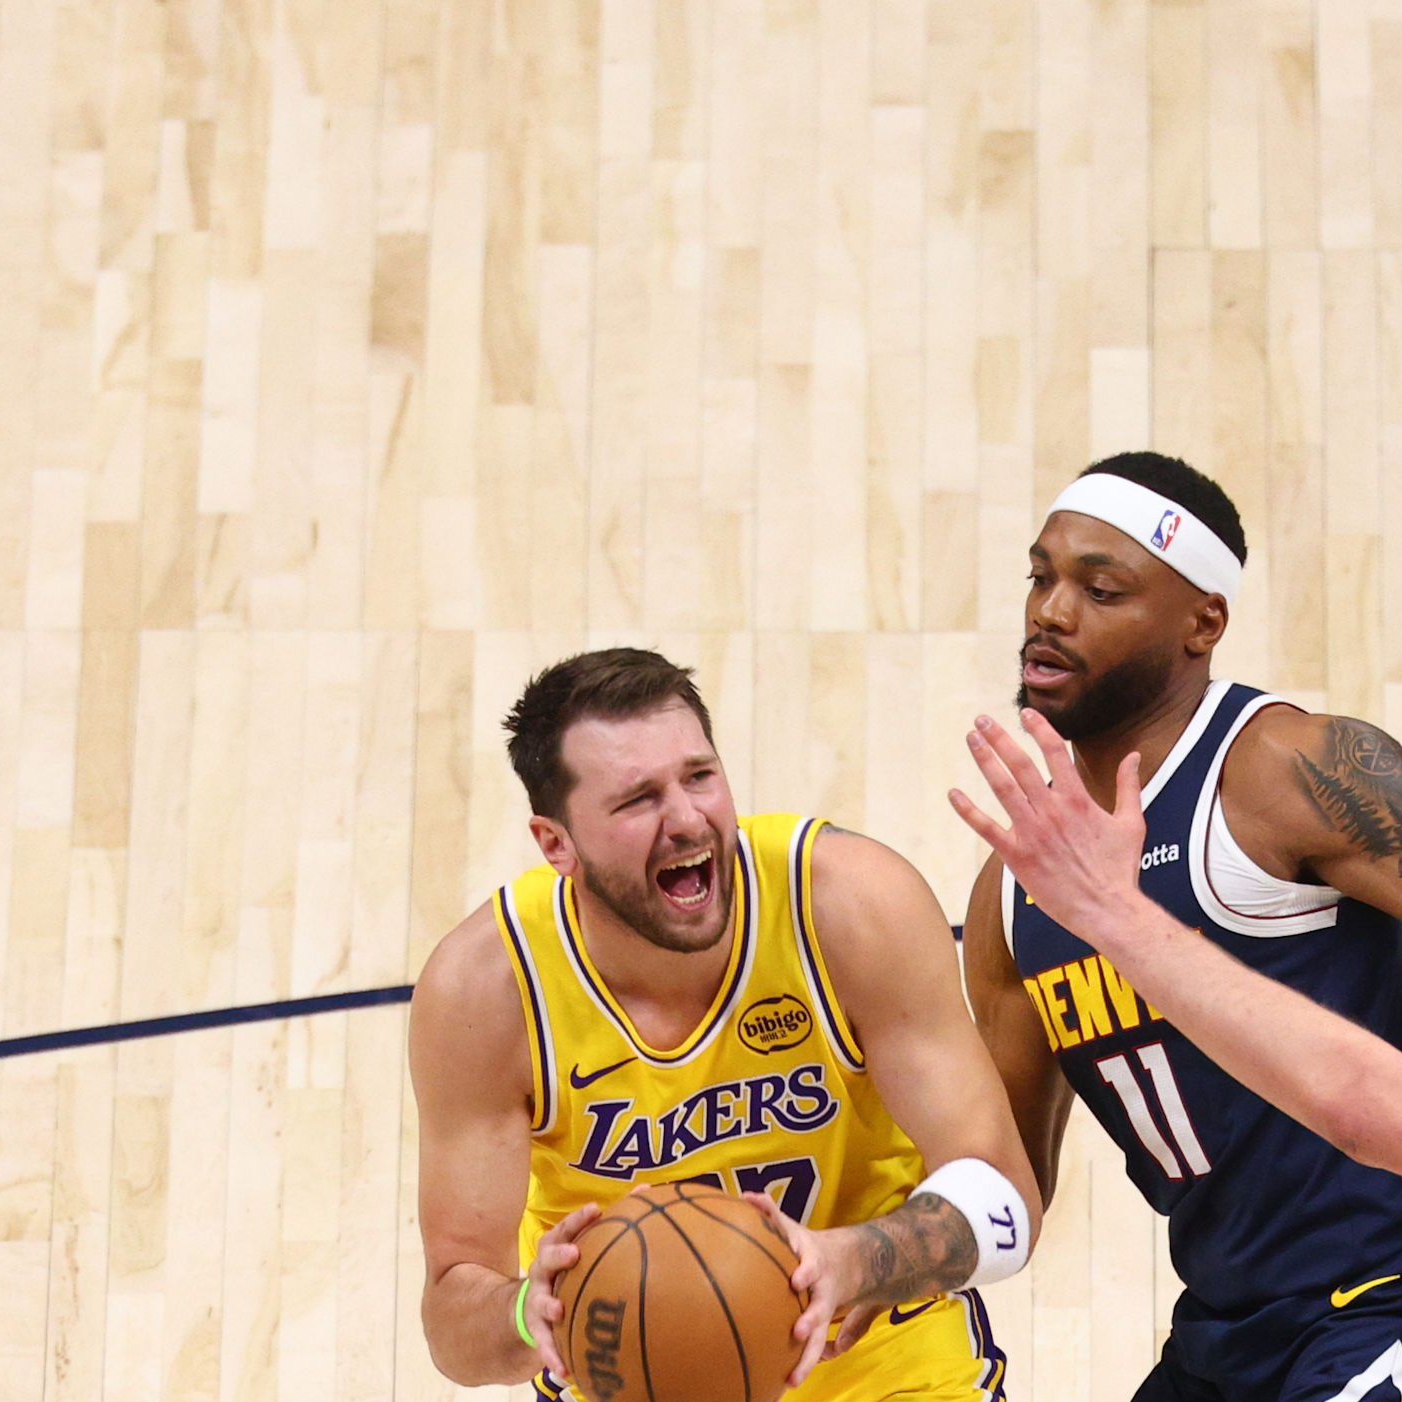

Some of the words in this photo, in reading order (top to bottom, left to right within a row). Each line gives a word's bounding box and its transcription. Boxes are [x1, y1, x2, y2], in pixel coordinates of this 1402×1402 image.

[1141, 843, 1180, 871] otta
[743, 1009, 807, 1038] bibigo
[568, 1063, 841, 1180] LAKERS
[1094, 1040, 1213, 1181] 11
[668, 1155, 822, 1229] 7
[987, 1205, 1017, 1252] 77
